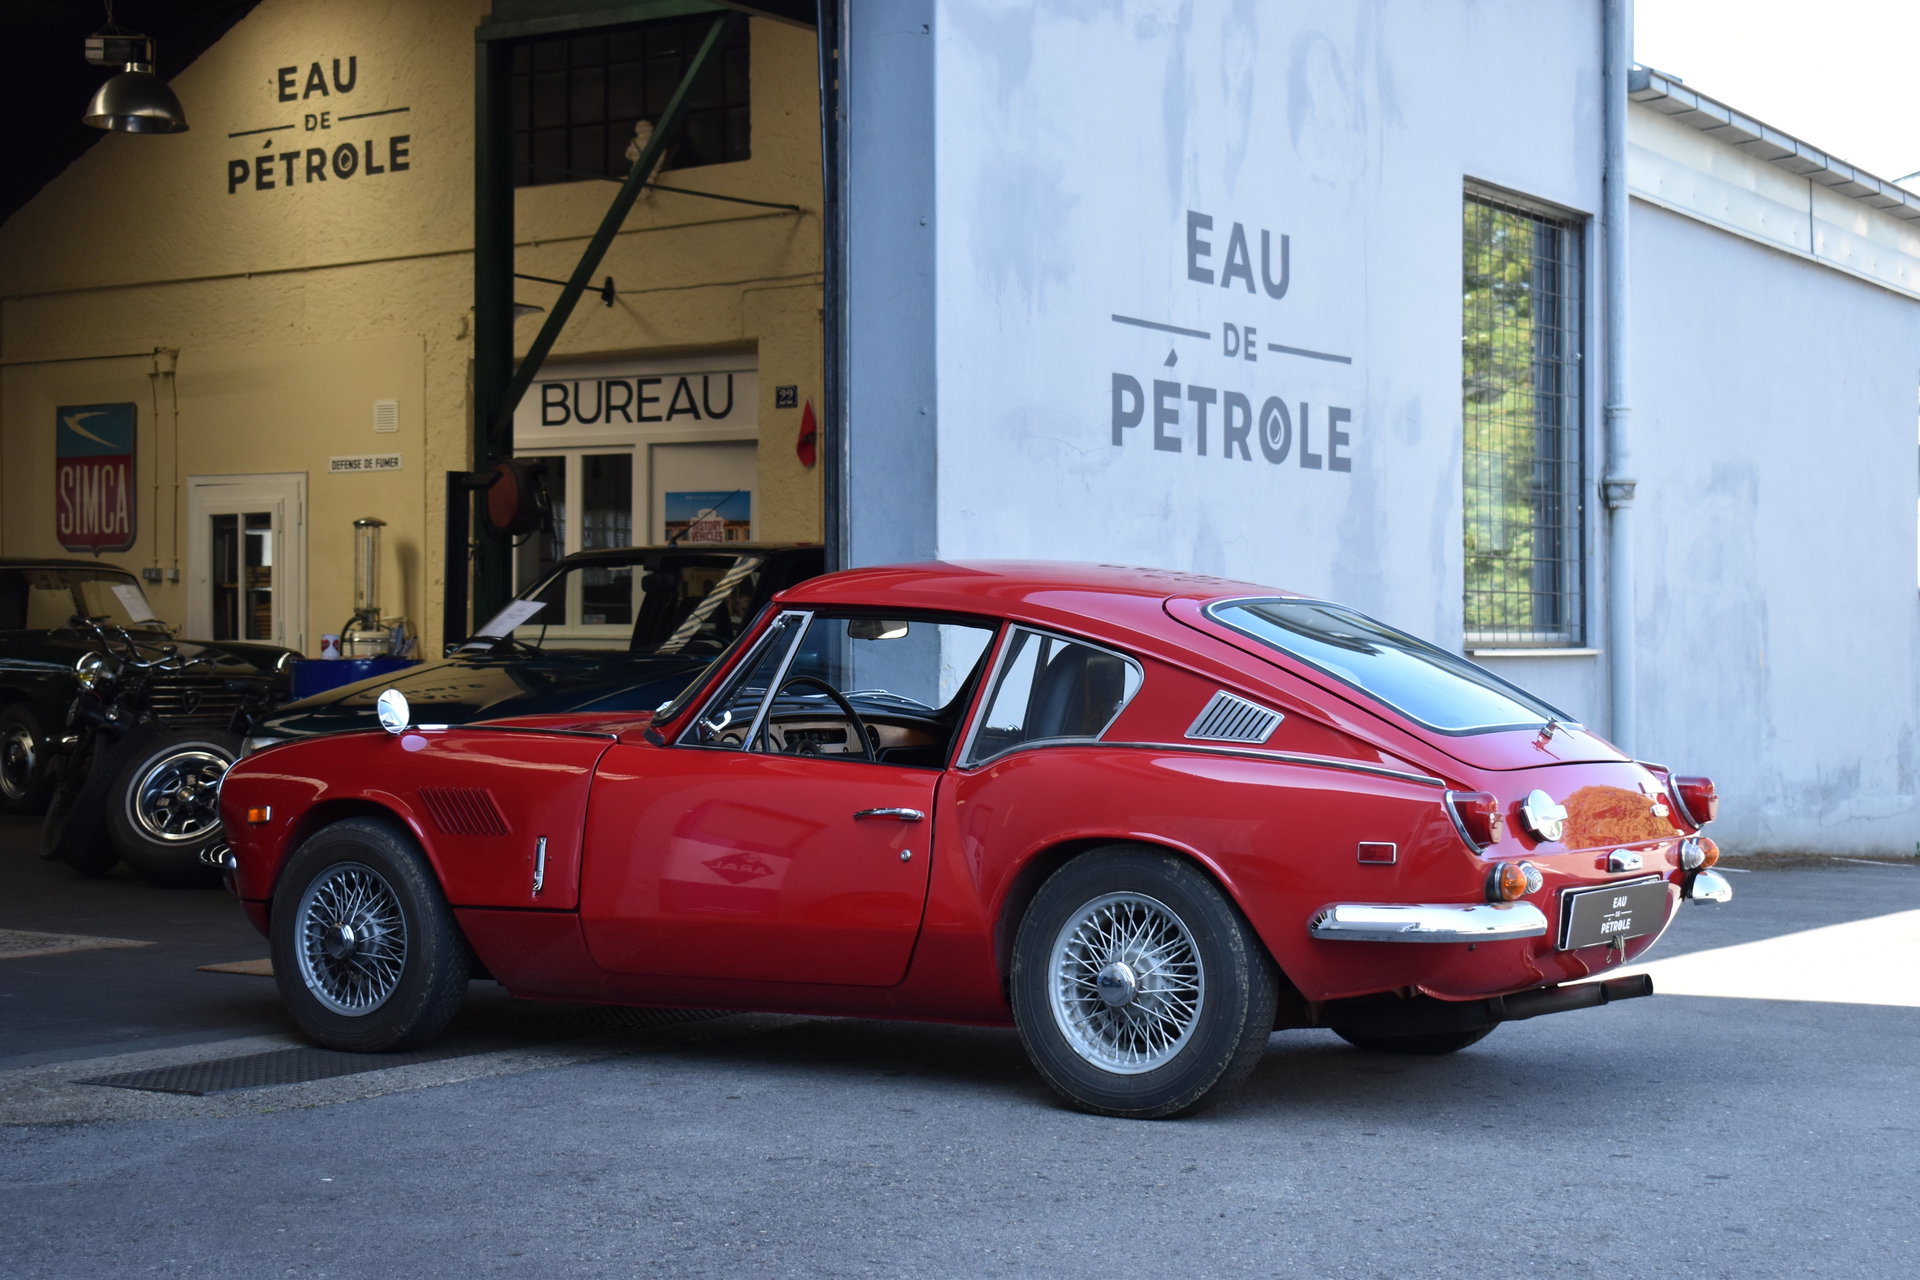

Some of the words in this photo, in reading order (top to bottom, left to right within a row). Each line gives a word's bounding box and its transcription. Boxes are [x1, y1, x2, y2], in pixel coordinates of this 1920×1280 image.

[278, 55, 357, 103] EAU
[304, 111, 331, 132] DE
[228, 134, 410, 194] PÉTROLE
[1187, 209, 1290, 300] EAU
[1223, 322, 1257, 362] DE
[542, 373, 733, 426] BUREAU
[779, 389, 794, 405] 22
[1111, 348, 1352, 473] PÉTROLE
[331, 459, 362, 470] DEFENSE
[364, 458, 373, 469] DE
[376, 457, 399, 468] FUMER
[61, 464, 129, 535] SIMCA
[1613, 896, 1627, 908] EAU
[1601, 918, 1631, 934] PÉTROLE
